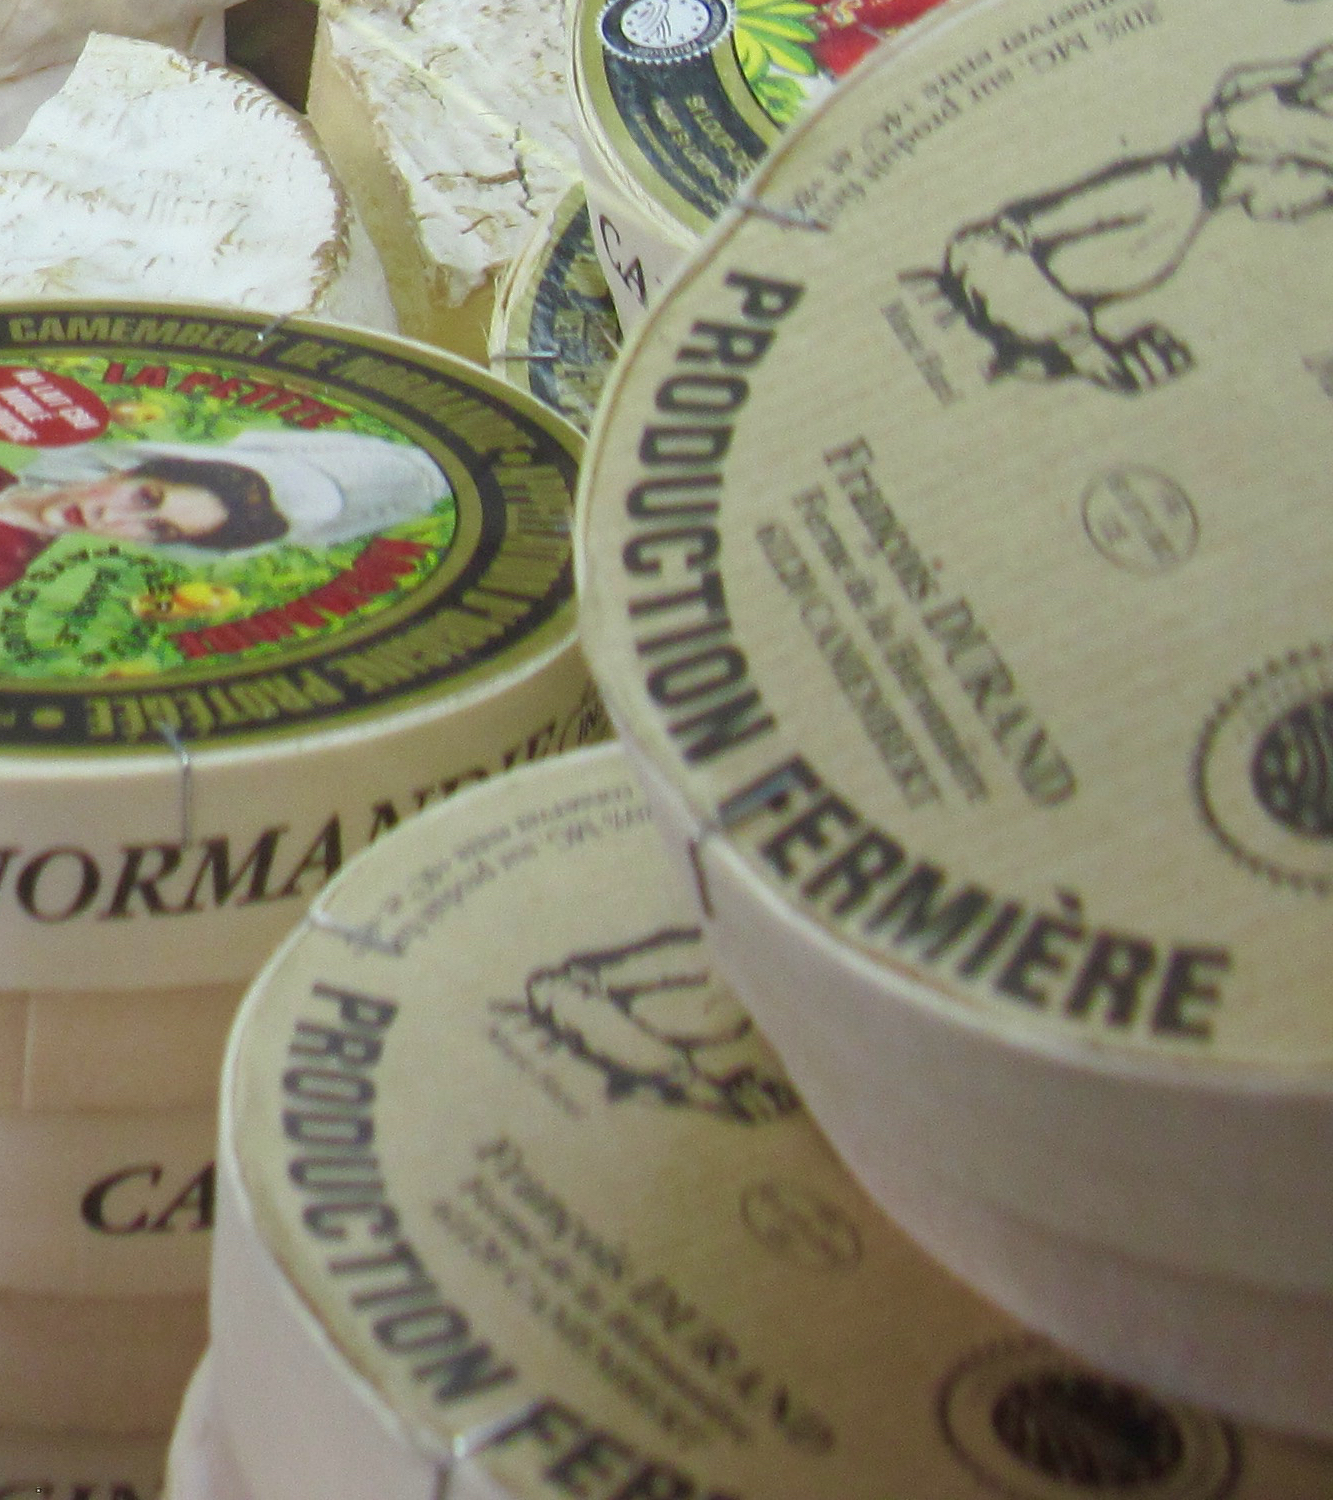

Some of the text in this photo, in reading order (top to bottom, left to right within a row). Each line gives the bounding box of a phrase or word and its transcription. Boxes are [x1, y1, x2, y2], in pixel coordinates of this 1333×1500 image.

[9, 315, 283, 360] CAMEMBERT
[102, 361, 352, 430] LA PETITE
[621, 271, 807, 767] PRODUCTION
[720, 755, 1229, 1044] FERMIÈRE
[282, 980, 519, 1409] PRODUCTION
